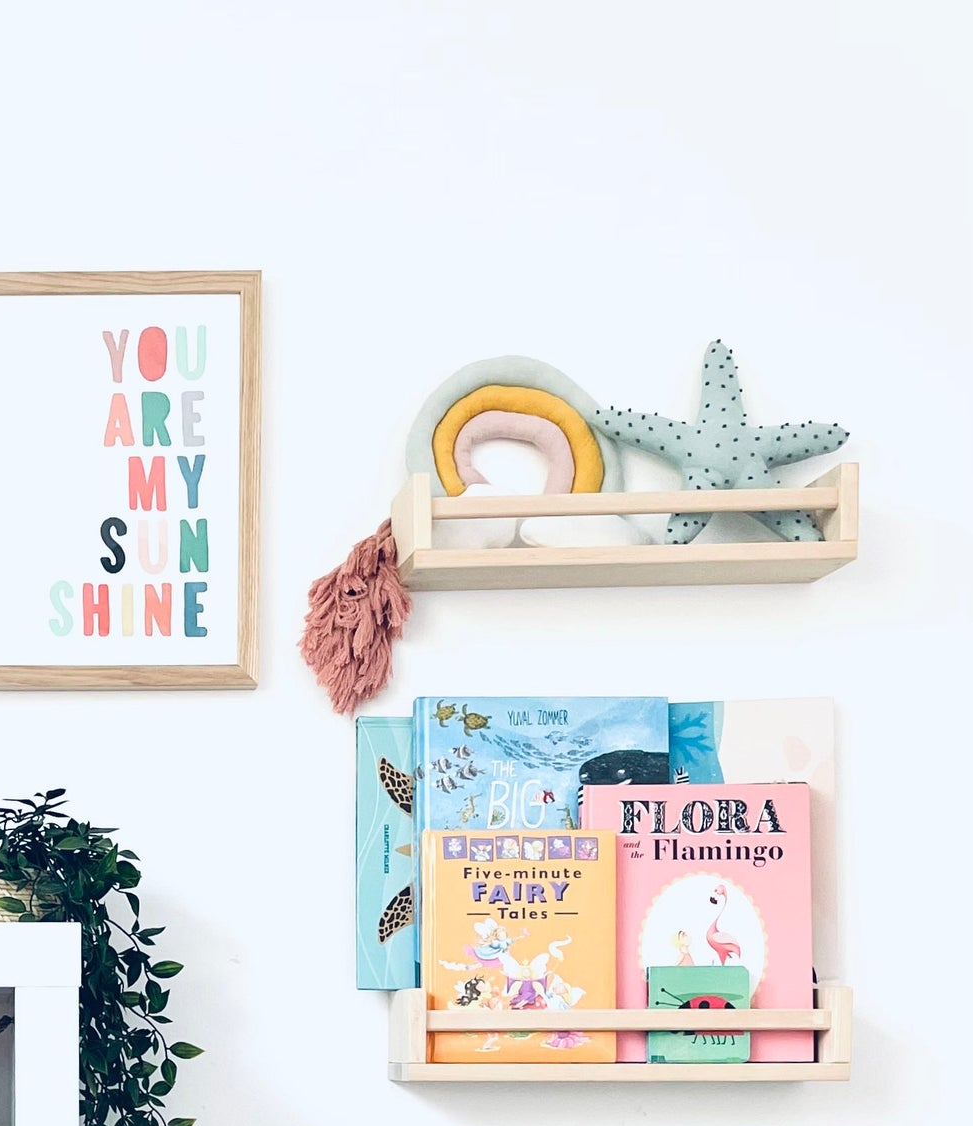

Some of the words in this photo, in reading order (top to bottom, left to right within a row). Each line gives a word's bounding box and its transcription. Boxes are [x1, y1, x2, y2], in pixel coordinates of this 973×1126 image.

[102, 325, 207, 383] YOU
[103, 391, 205, 447] ARE
[128, 454, 206, 511] MY
[100, 517, 209, 574] SUN
[49, 580, 208, 637] SHINE
[508, 710, 532, 726] YUVAL
[538, 709, 568, 726] ZOMMER
[491, 760, 517, 777] THE
[487, 780, 546, 830] BIG
[619, 799, 787, 835] FLORA
[631, 851, 644, 859] the
[653, 839, 784, 868] Flamingo
[463, 867, 582, 879] Five-minute
[472, 881, 570, 905] FAIRY
[497, 907, 548, 920] Tales
